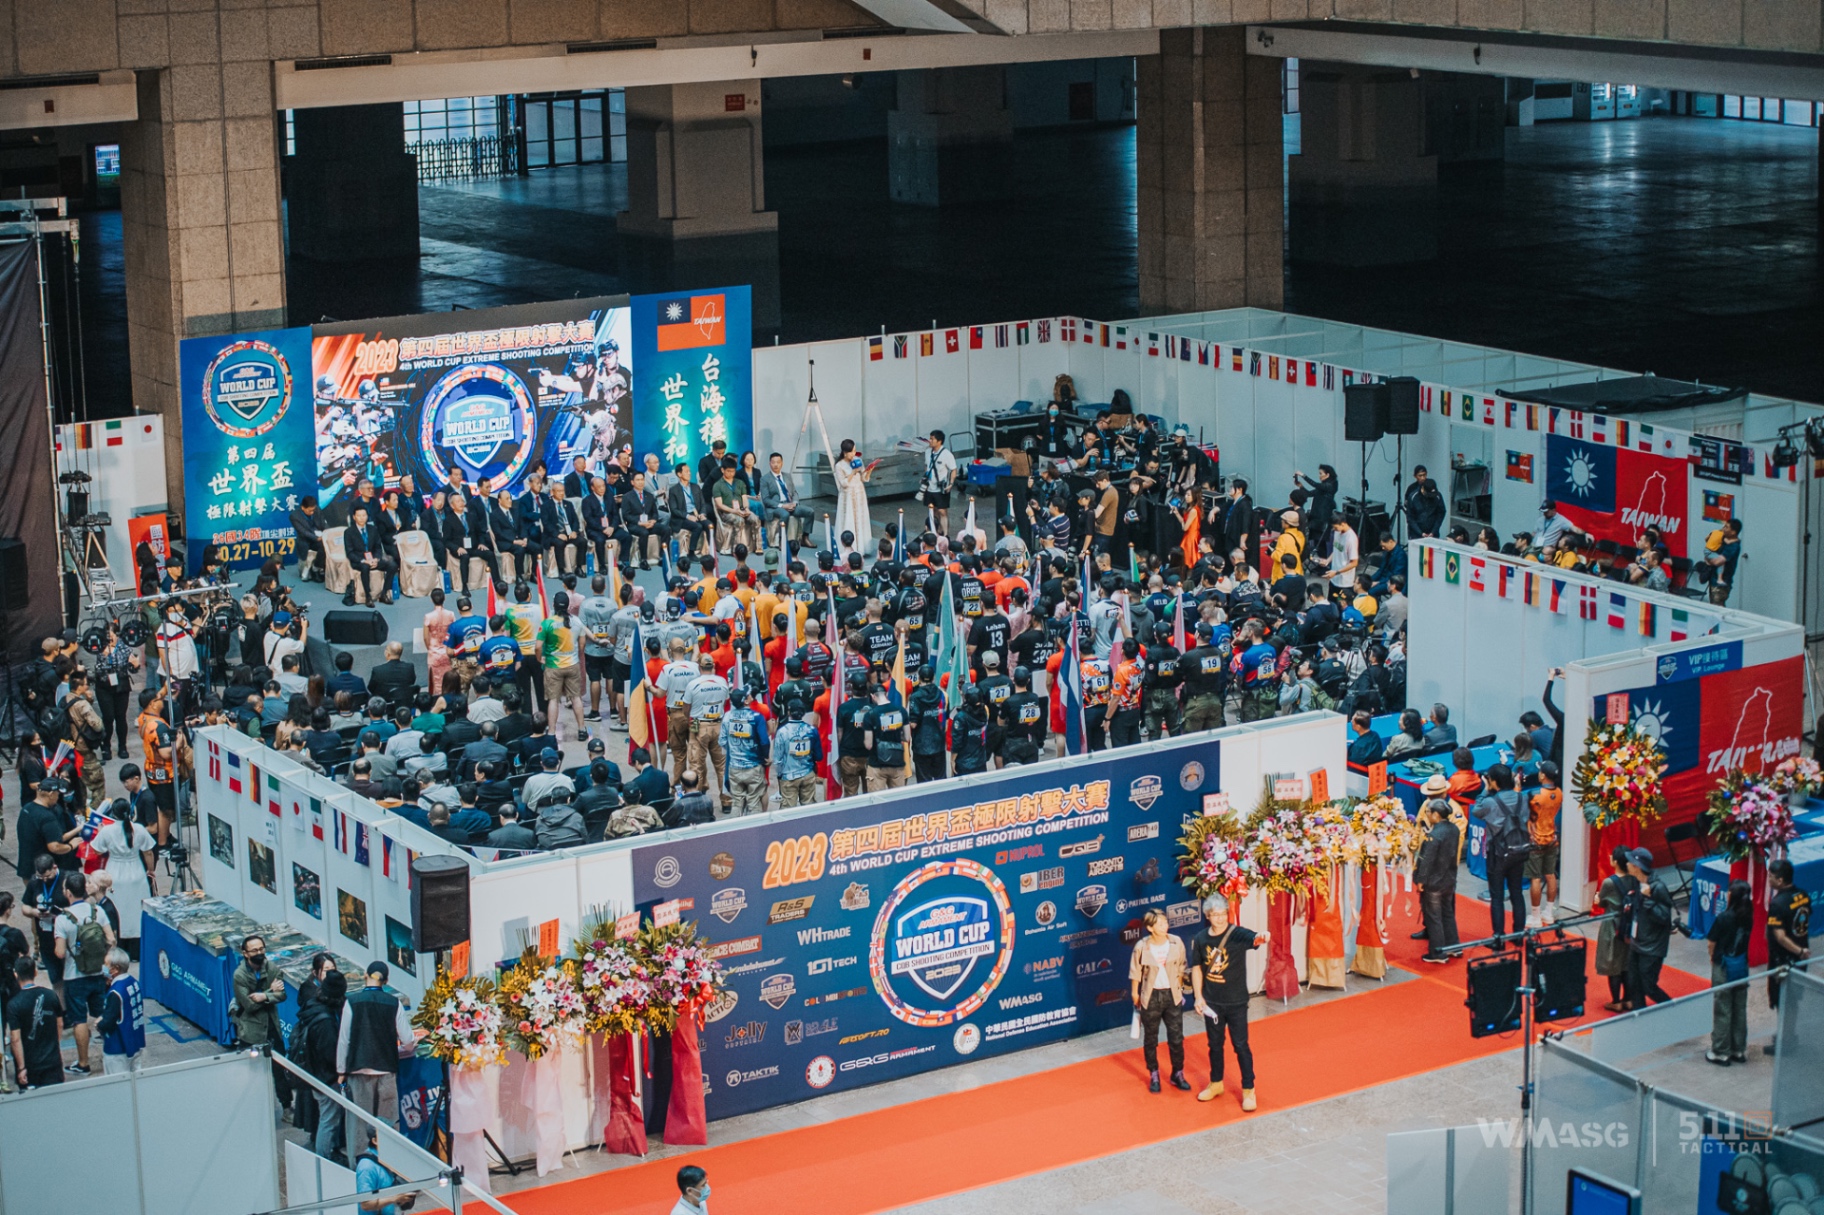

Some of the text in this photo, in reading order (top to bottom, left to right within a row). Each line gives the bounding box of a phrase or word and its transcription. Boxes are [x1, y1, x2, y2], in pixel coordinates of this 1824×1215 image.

[694, 316, 721, 325] TAIWAN
[399, 319, 596, 361] 第四屆世界盃極限射擊大賽
[353, 339, 398, 376] 2023
[399, 341, 595, 371] 4th WORLD CUP EXTREME SHOOTING COMPETITION
[220, 376, 276, 394] WORLD CUP
[699, 353, 726, 449] 台海穩
[446, 416, 510, 436] WORLD CUP
[660, 372, 690, 466] 世界和
[226, 442, 276, 465] 第四屆
[208, 461, 294, 496] 世界盃
[206, 493, 300, 520] 極限射擊大賽
[1621, 507, 1682, 534] TAIWAN
[961, 586, 981, 598] ORIGIN
[969, 603, 978, 612] 22
[739, 623, 744, 631] 9
[909, 617, 919, 625] 65
[598, 625, 608, 633] 51
[472, 639, 477, 647] 1
[870, 634, 893, 643] TEAM
[991, 630, 1003, 648] 13
[905, 653, 920, 661] EAM
[1207, 658, 1217, 668] 19
[1263, 665, 1272, 674] 56
[1703, 663, 1725, 672] Lounge
[1097, 677, 1106, 687] 61
[995, 688, 1005, 698] 27
[708, 705, 719, 714] 47
[1026, 708, 1036, 718] 28
[889, 715, 894, 724] 7
[733, 723, 744, 733] 42
[795, 742, 807, 751] 41
[1130, 784, 1161, 796] WORLD CUP
[829, 780, 1111, 861] 第四屆世界盃極限射擊大賽
[1129, 826, 1148, 839] ARENA
[829, 812, 1110, 876] 4th WORLD CUP EXTREME SHOOTING COMPETITION
[1009, 844, 1045, 862] NUPROL
[762, 832, 828, 889] 2023
[1088, 856, 1124, 870] TORONTO
[1038, 866, 1064, 881] IBER
[1038, 878, 1064, 889] engine
[711, 896, 746, 909] WORLD CUP
[1077, 892, 1107, 904] WORLD CUP
[1128, 893, 1166, 908] PATROL BASE
[777, 899, 806, 912] R&S
[930, 905, 955, 918] G&G
[770, 909, 805, 921] TRADERS
[918, 911, 967, 930] ARMAMENT
[1056, 921, 1067, 929] Soft
[896, 921, 990, 958] WORLD CUP
[1124, 928, 1140, 941] TMH
[728, 938, 760, 954] COMBAT
[911, 954, 944, 968] SHOOTING
[945, 943, 990, 960] COMPETITION
[807, 956, 857, 976] 101 TECH
[1033, 955, 1064, 972] NABV
[1076, 961, 1096, 975] CAI
[925, 964, 962, 980] 2023
[761, 981, 795, 995] WORLD CUP
[999, 992, 1043, 1010] WMASG
[725, 1020, 767, 1042] Jolly
[1006, 1029, 1025, 1037] Defense
[1025, 1023, 1049, 1033] Education
[1049, 1016, 1077, 1026] Association
[840, 1045, 936, 1071] G&G ARMAMENT
[742, 1065, 780, 1080] TAKTIK
